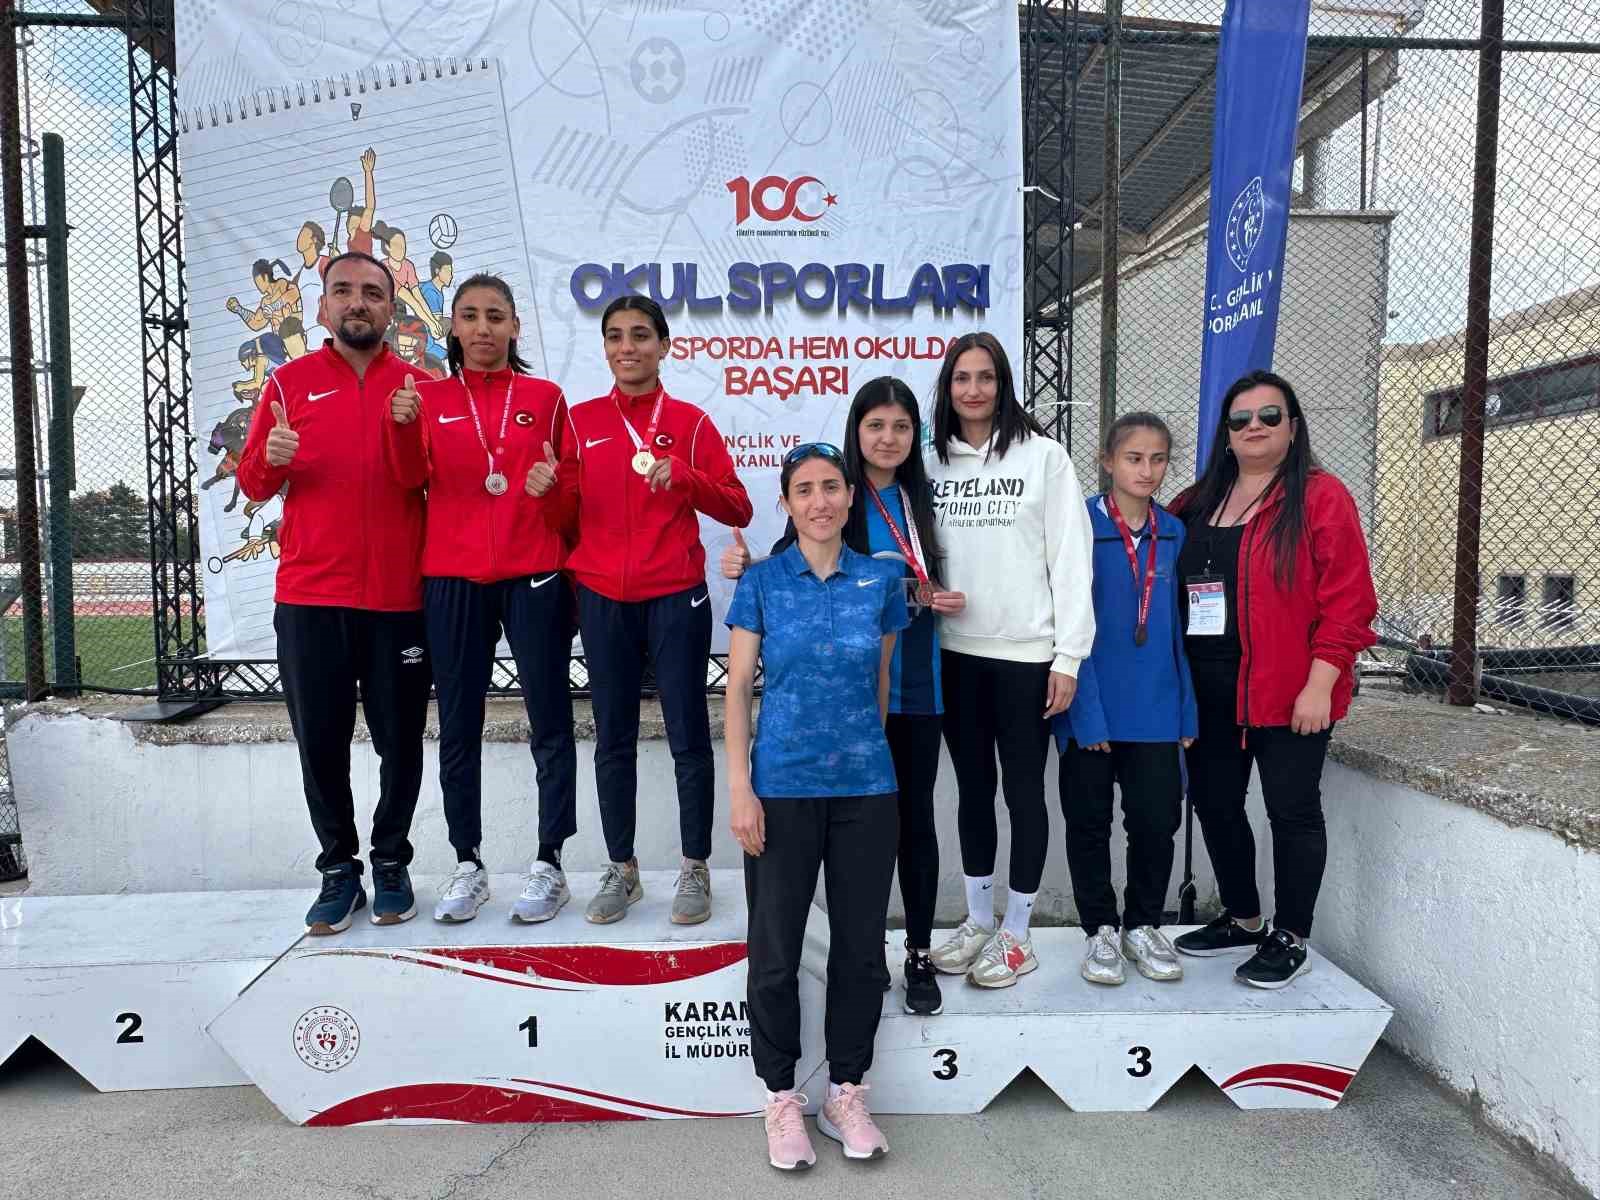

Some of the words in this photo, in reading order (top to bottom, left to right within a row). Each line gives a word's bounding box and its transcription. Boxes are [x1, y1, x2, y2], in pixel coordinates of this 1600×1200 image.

[570, 262, 724, 313] OKUL
[726, 262, 990, 314] SPORLARI
[672, 336, 784, 360] SPORDA
[789, 336, 849, 359] HEM
[724, 366, 849, 400] BAŞARI
[724, 432, 774, 451] NÇLİK
[780, 435, 800, 448] VE
[731, 454, 784, 467] KANLI
[929, 478, 1024, 498] LEVELAND
[949, 501, 981, 516] OHIO
[987, 500, 1021, 515] CITY
[115, 1012, 144, 1044] 2
[519, 1015, 538, 1048] 1
[665, 1023, 732, 1040] GENÇLİK
[665, 1042, 681, 1059] İL
[686, 1041, 750, 1059] MÜDÜR
[1126, 1045, 1152, 1078] 3
[932, 1048, 959, 1081] 3
